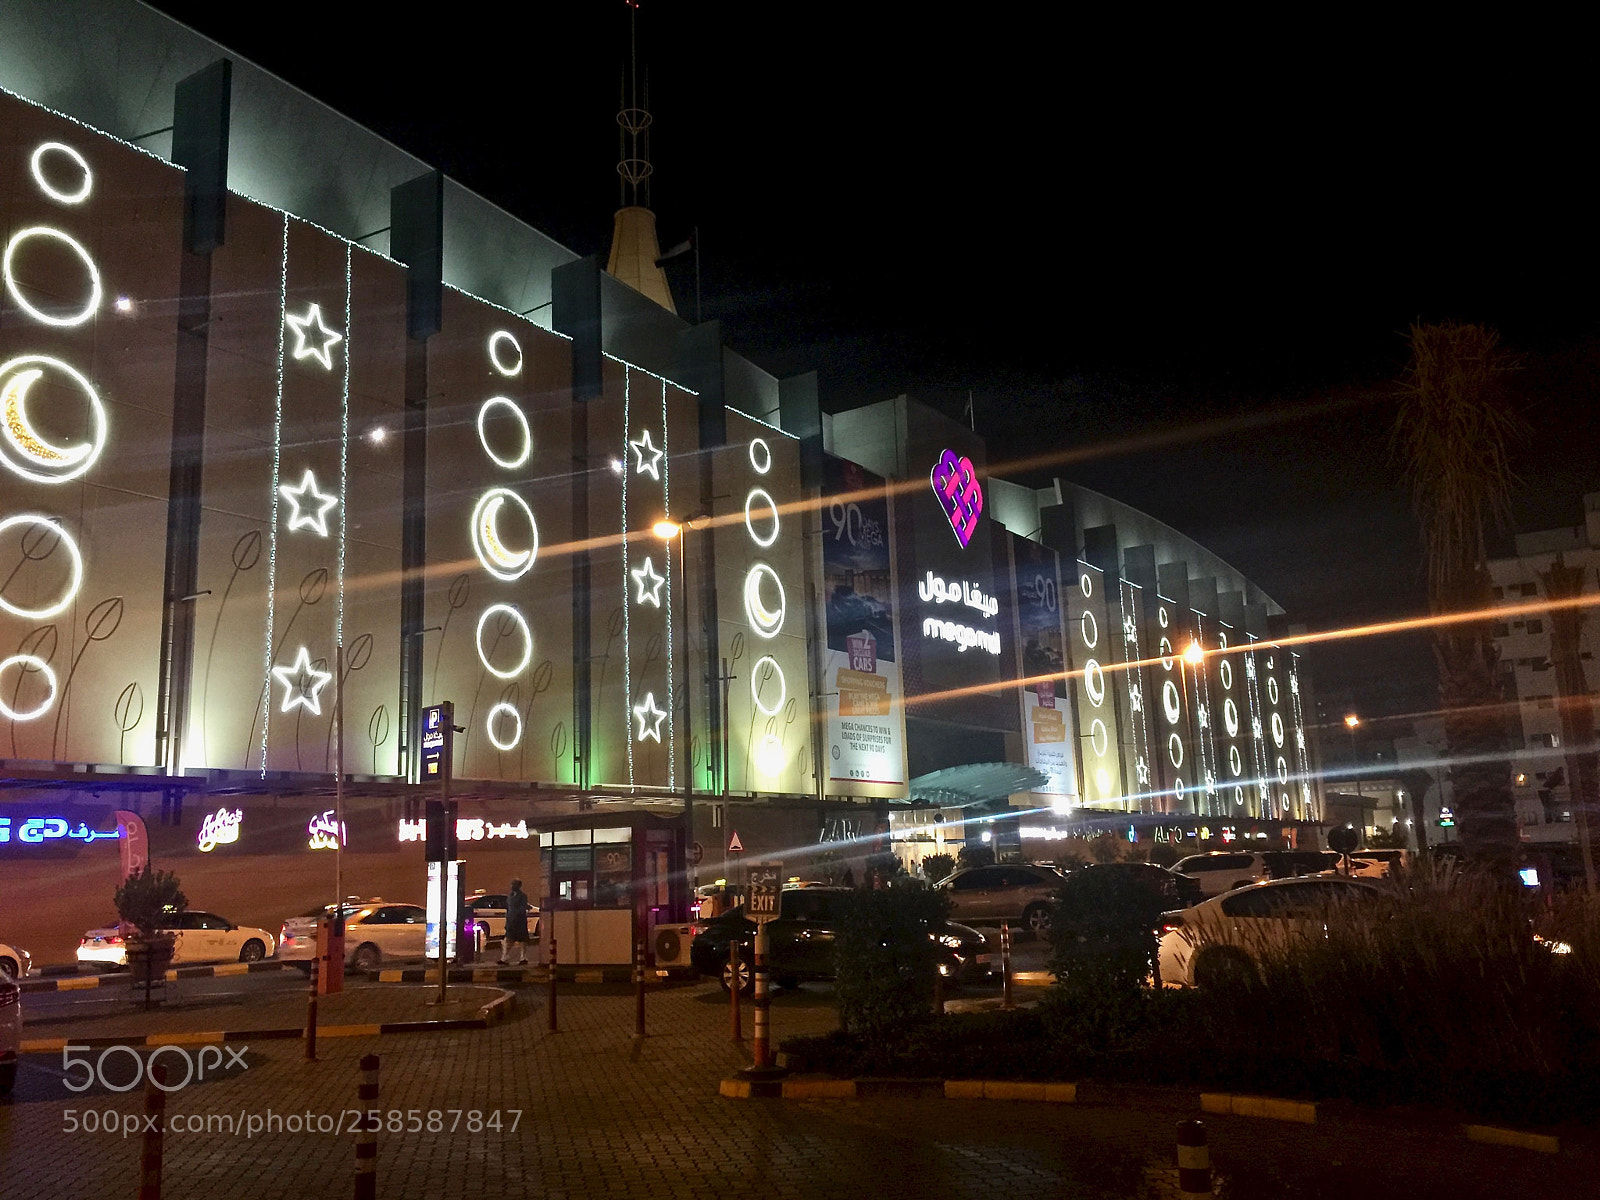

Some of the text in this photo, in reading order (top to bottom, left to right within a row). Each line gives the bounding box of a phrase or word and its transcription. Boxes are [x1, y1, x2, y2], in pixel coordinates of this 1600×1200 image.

[830, 497, 862, 547] 90
[919, 570, 962, 603] مول
[1035, 574, 1056, 612] 90
[862, 629, 872, 649] 2
[853, 656, 873, 672] CARS
[841, 721, 854, 731] MEGA
[854, 723, 873, 733] CHANCES
[841, 731, 892, 745] LOADS OF SURPRISES FOR
[850, 742, 858, 751] THE
[859, 743, 869, 752] NEXT
[751, 869, 777, 885] مخرج
[751, 893, 776, 911] EXIT
